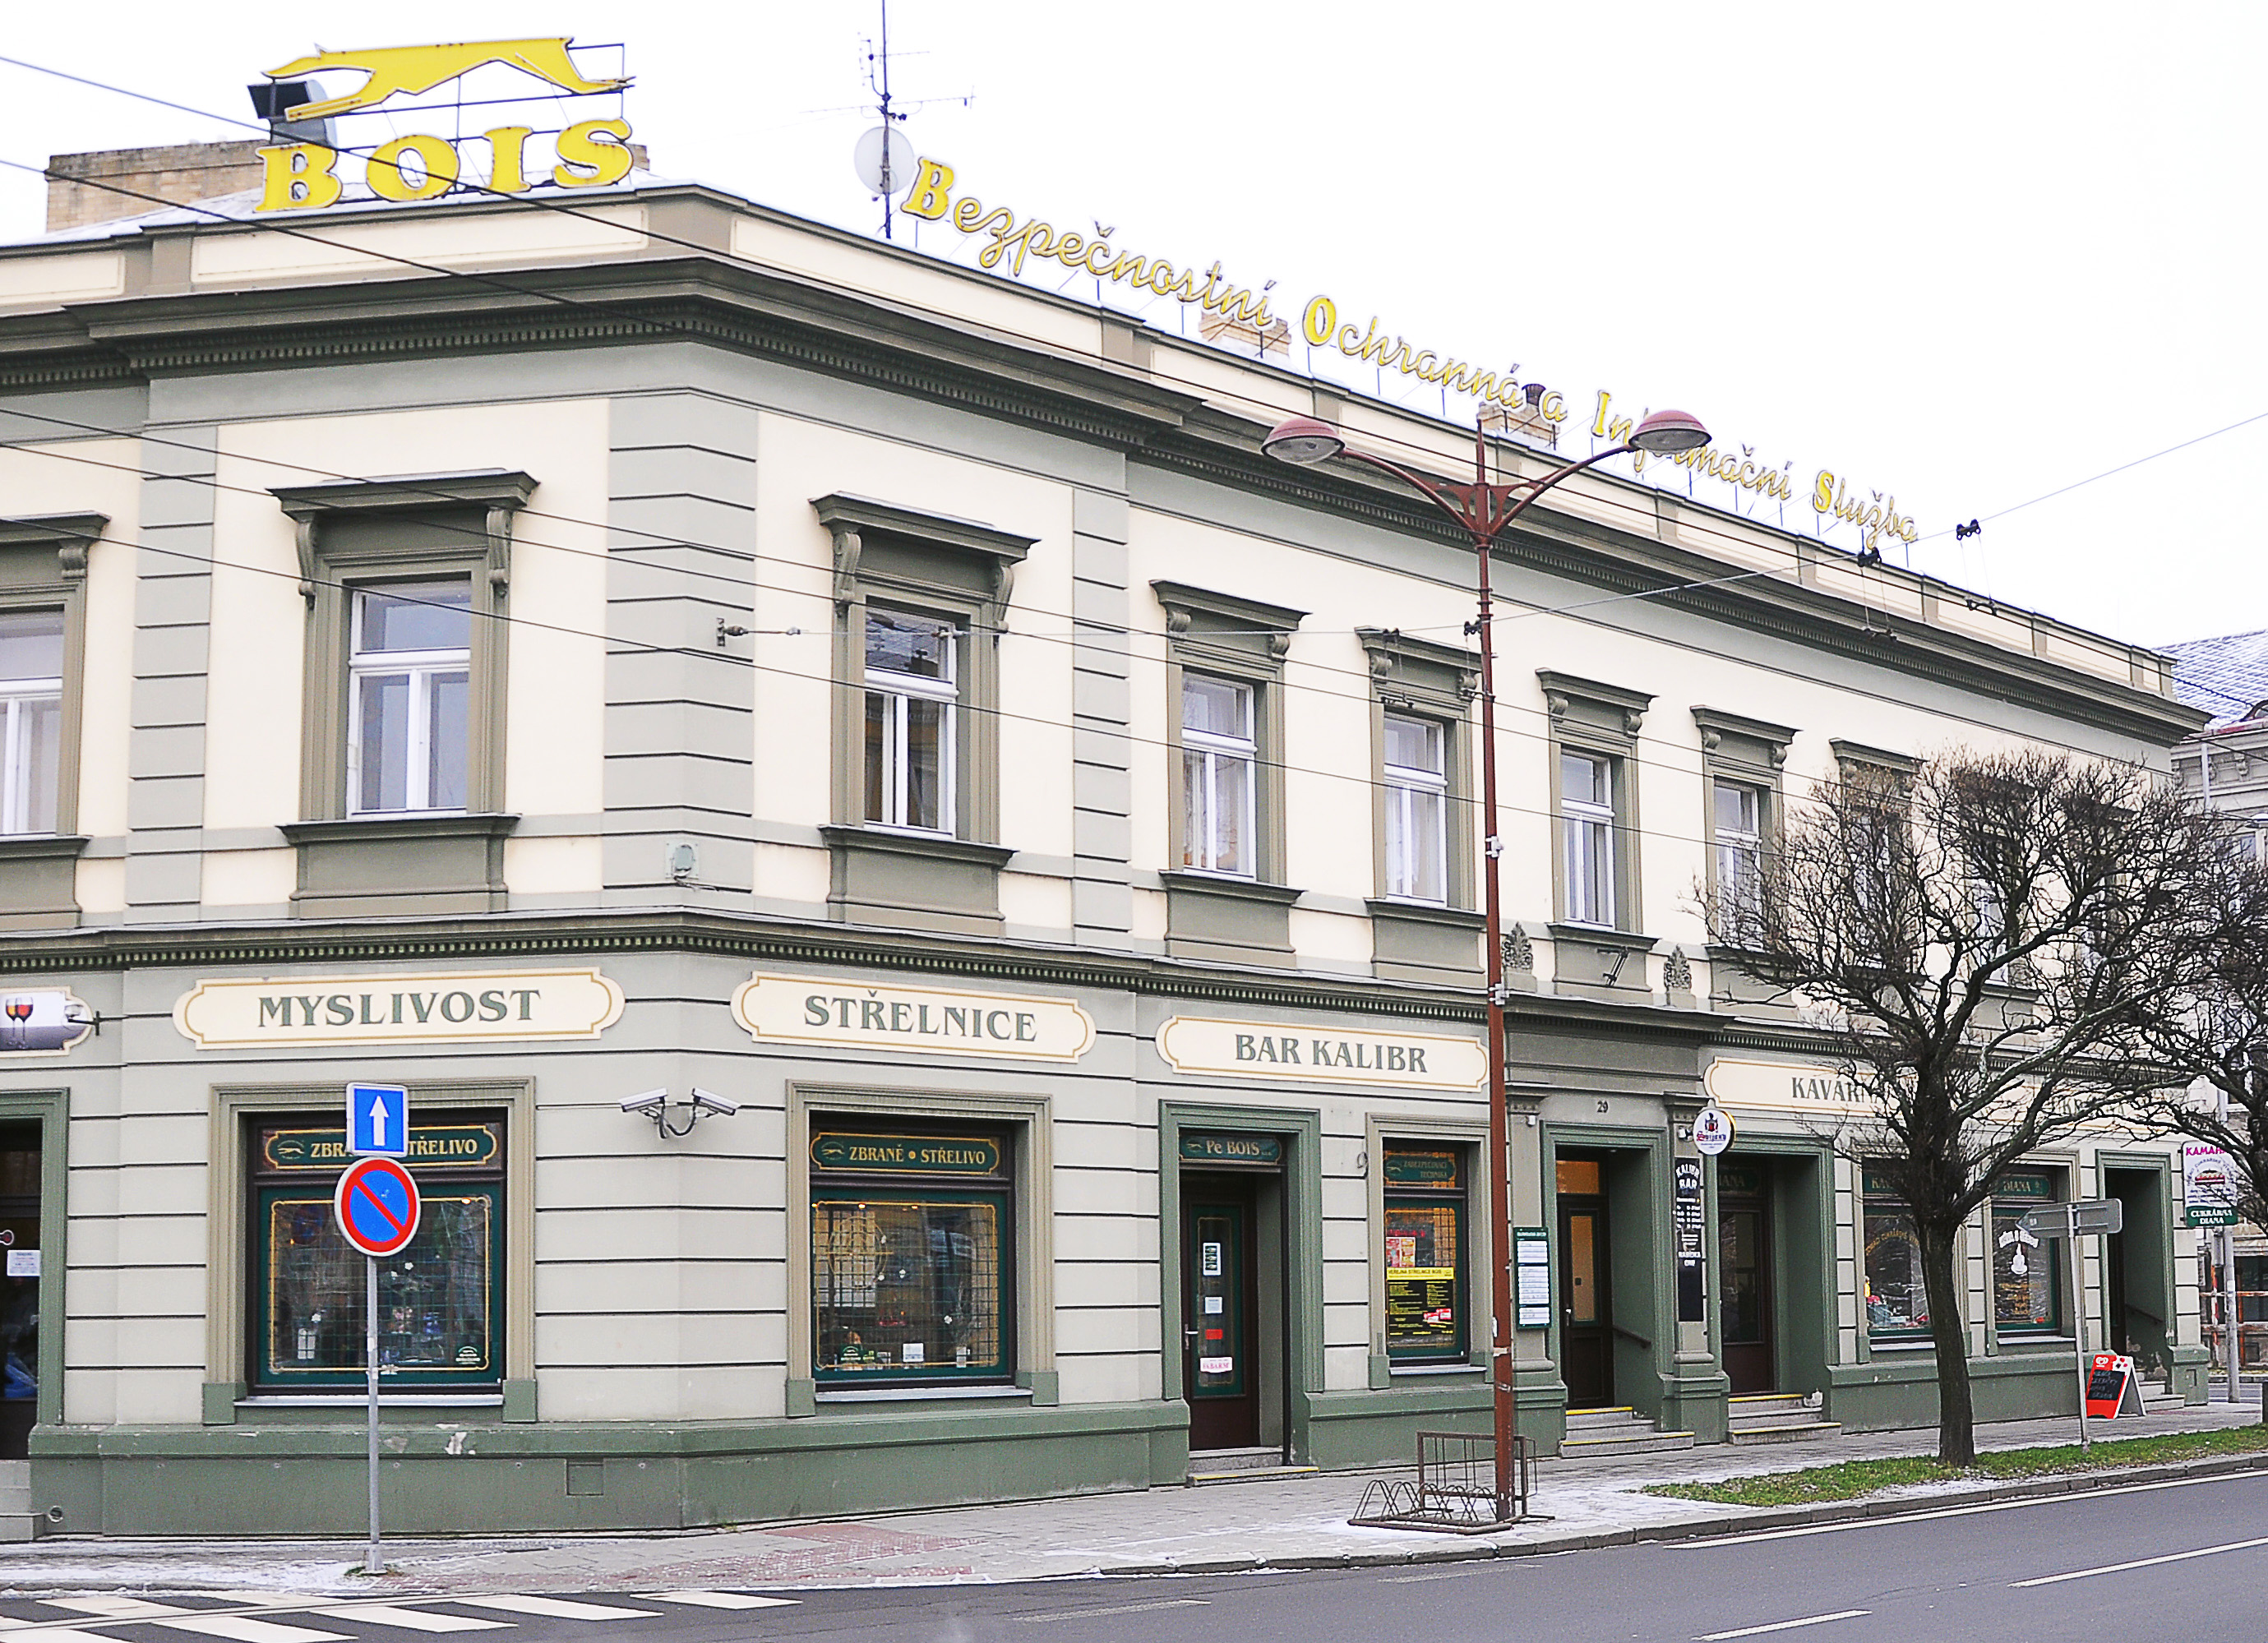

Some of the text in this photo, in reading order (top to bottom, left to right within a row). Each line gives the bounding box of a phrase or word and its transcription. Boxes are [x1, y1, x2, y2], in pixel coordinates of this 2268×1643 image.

[253, 118, 633, 213] BOIS
[900, 156, 1277, 326] Bezpečnostní
[1302, 295, 1523, 409] Ochranná
[1542, 391, 1568, 422] a
[1813, 469, 1919, 549] Služba
[258, 989, 541, 1027] MYSLIVOST
[804, 989, 1037, 1042] STŘELNICE
[1236, 1033, 1428, 1073] BAR KALIBR
[1596, 1100, 1609, 1114] 29
[408, 1135, 478, 1156] TŘELIVO
[921, 1147, 986, 1164] STŘELIVO
[1206, 1139, 1223, 1154] Pe
[1227, 1140, 1260, 1156] BOIS
